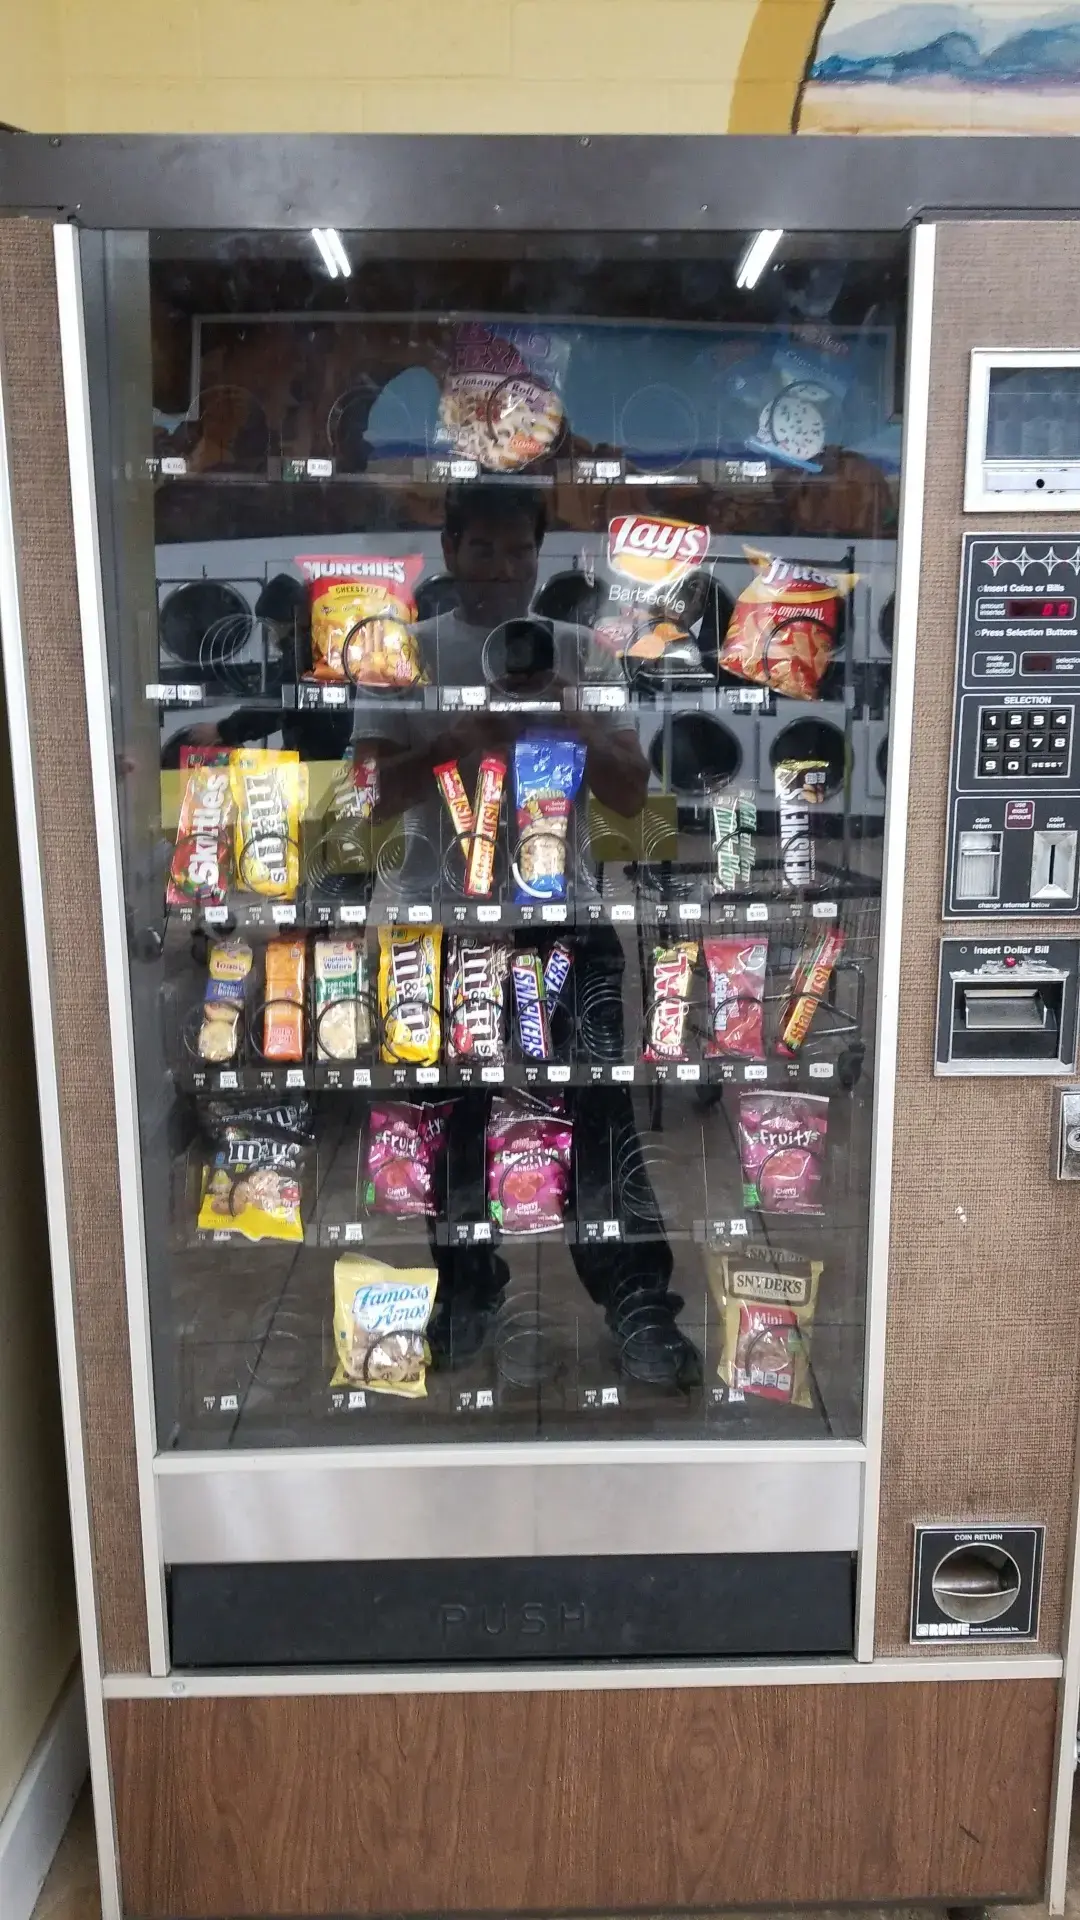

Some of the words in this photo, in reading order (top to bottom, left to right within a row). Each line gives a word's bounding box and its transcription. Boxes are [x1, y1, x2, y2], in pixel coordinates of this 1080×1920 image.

[512, 382, 534, 396] Roll
[613, 517, 705, 559] Lay's
[303, 562, 405, 583] MUNCHIES
[983, 584, 1007, 592] Insert
[1009, 584, 1033, 592] Coins
[1046, 584, 1065, 592] Bills
[609, 584, 685, 613] Barbecue
[778, 608, 825, 621] ORIGINAL
[981, 628, 1004, 636] Press
[1006, 628, 1044, 636] Selection
[1046, 628, 1078, 636] Buttons
[1004, 696, 1052, 704] SELECTION
[989, 716, 996, 726] 1
[1010, 715, 1022, 725] 2
[1033, 716, 1044, 726] 3
[1056, 715, 1066, 724] 4
[986, 738, 998, 748] 5
[1009, 738, 1020, 748] 6
[1032, 738, 1043, 748] 7
[1054, 738, 1066, 748] 8
[985, 761, 996, 770] 9
[1008, 761, 1019, 770] 0
[780, 787, 810, 886] HERSHEY'S
[974, 946, 1002, 954] Insert
[1004, 946, 1032, 954] Dollar
[1034, 945, 1050, 954] Bill
[324, 962, 352, 970] Wafers
[513, 966, 547, 1059] SNICKERS
[776, 1188, 797, 1196] Cherry
[736, 1274, 802, 1294] SNYDER'S
[353, 1286, 429, 1310] Famous
[368, 1304, 426, 1330] Amos
[754, 1312, 783, 1325] Mini
[206, 1402, 214, 1410] 17
[440, 1602, 586, 1635] PUSH
[928, 1623, 970, 1636] ROWE
